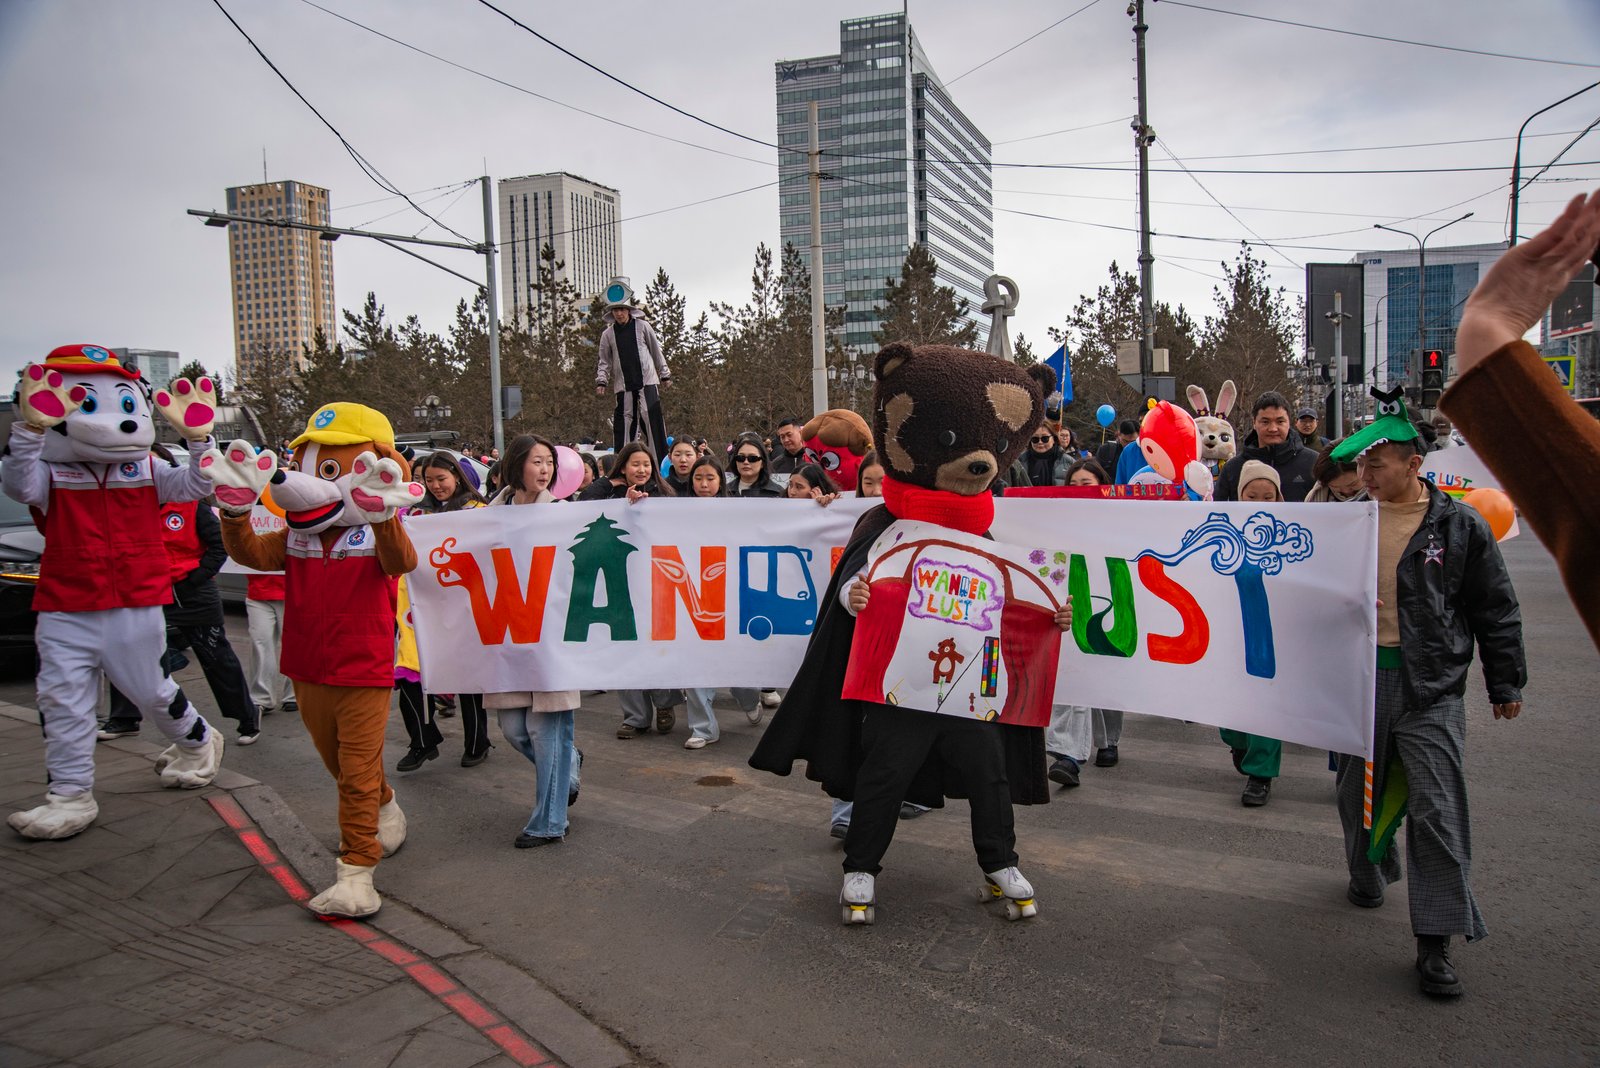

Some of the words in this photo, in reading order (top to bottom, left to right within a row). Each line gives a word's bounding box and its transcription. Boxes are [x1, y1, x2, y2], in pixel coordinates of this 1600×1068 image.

[1101, 485, 1183, 497] WANDERLUST
[1416, 471, 1472, 489] RLUST
[429, 512, 1314, 679] WANDUST
[918, 567, 987, 601] WANDER
